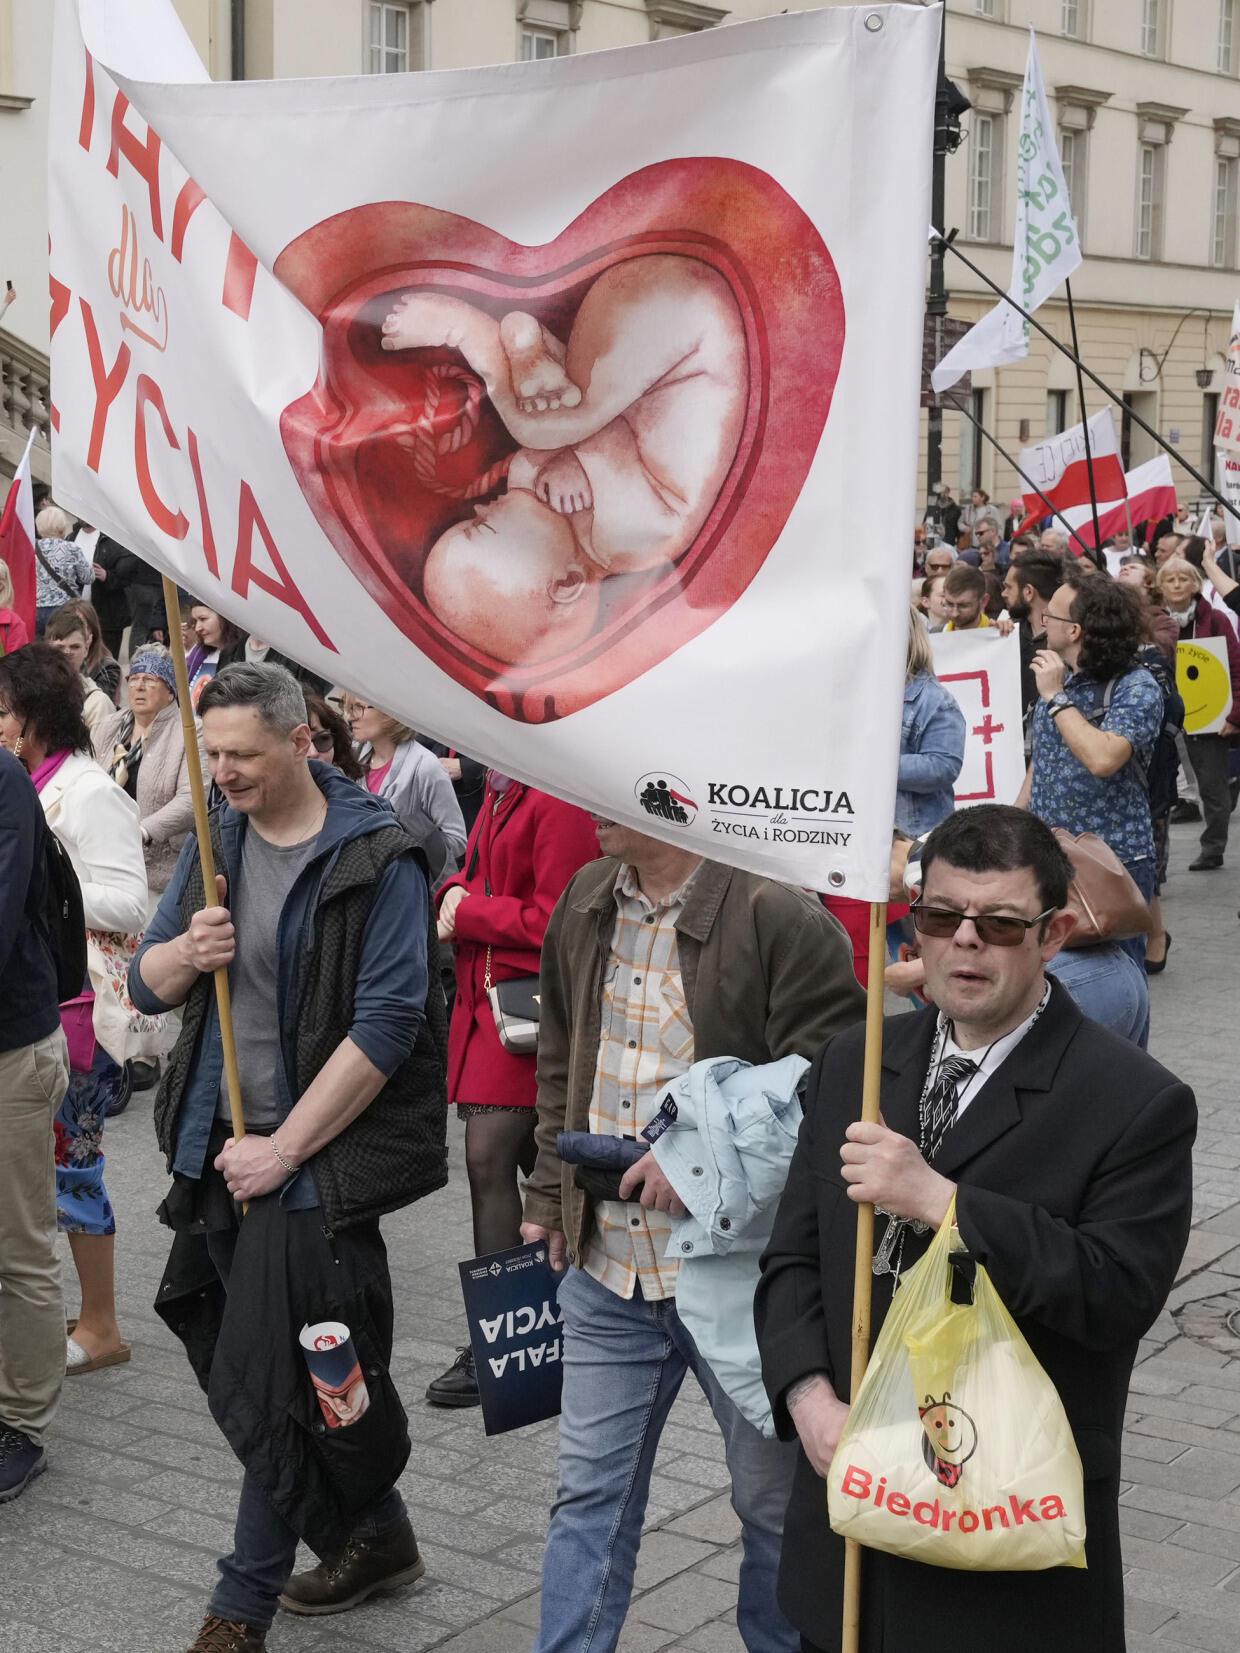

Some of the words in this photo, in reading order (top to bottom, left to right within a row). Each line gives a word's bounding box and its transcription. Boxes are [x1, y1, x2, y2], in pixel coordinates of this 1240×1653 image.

[107, 203, 168, 351] dla
[707, 783, 855, 814] KOALICJA
[711, 818, 761, 840] ŻYCIA
[763, 828, 769, 841] i
[772, 828, 852, 847] RODZINY
[770, 813, 788, 825] dla
[478, 1301, 564, 1344] YCIA
[840, 1464, 1068, 1534] Biedronka
